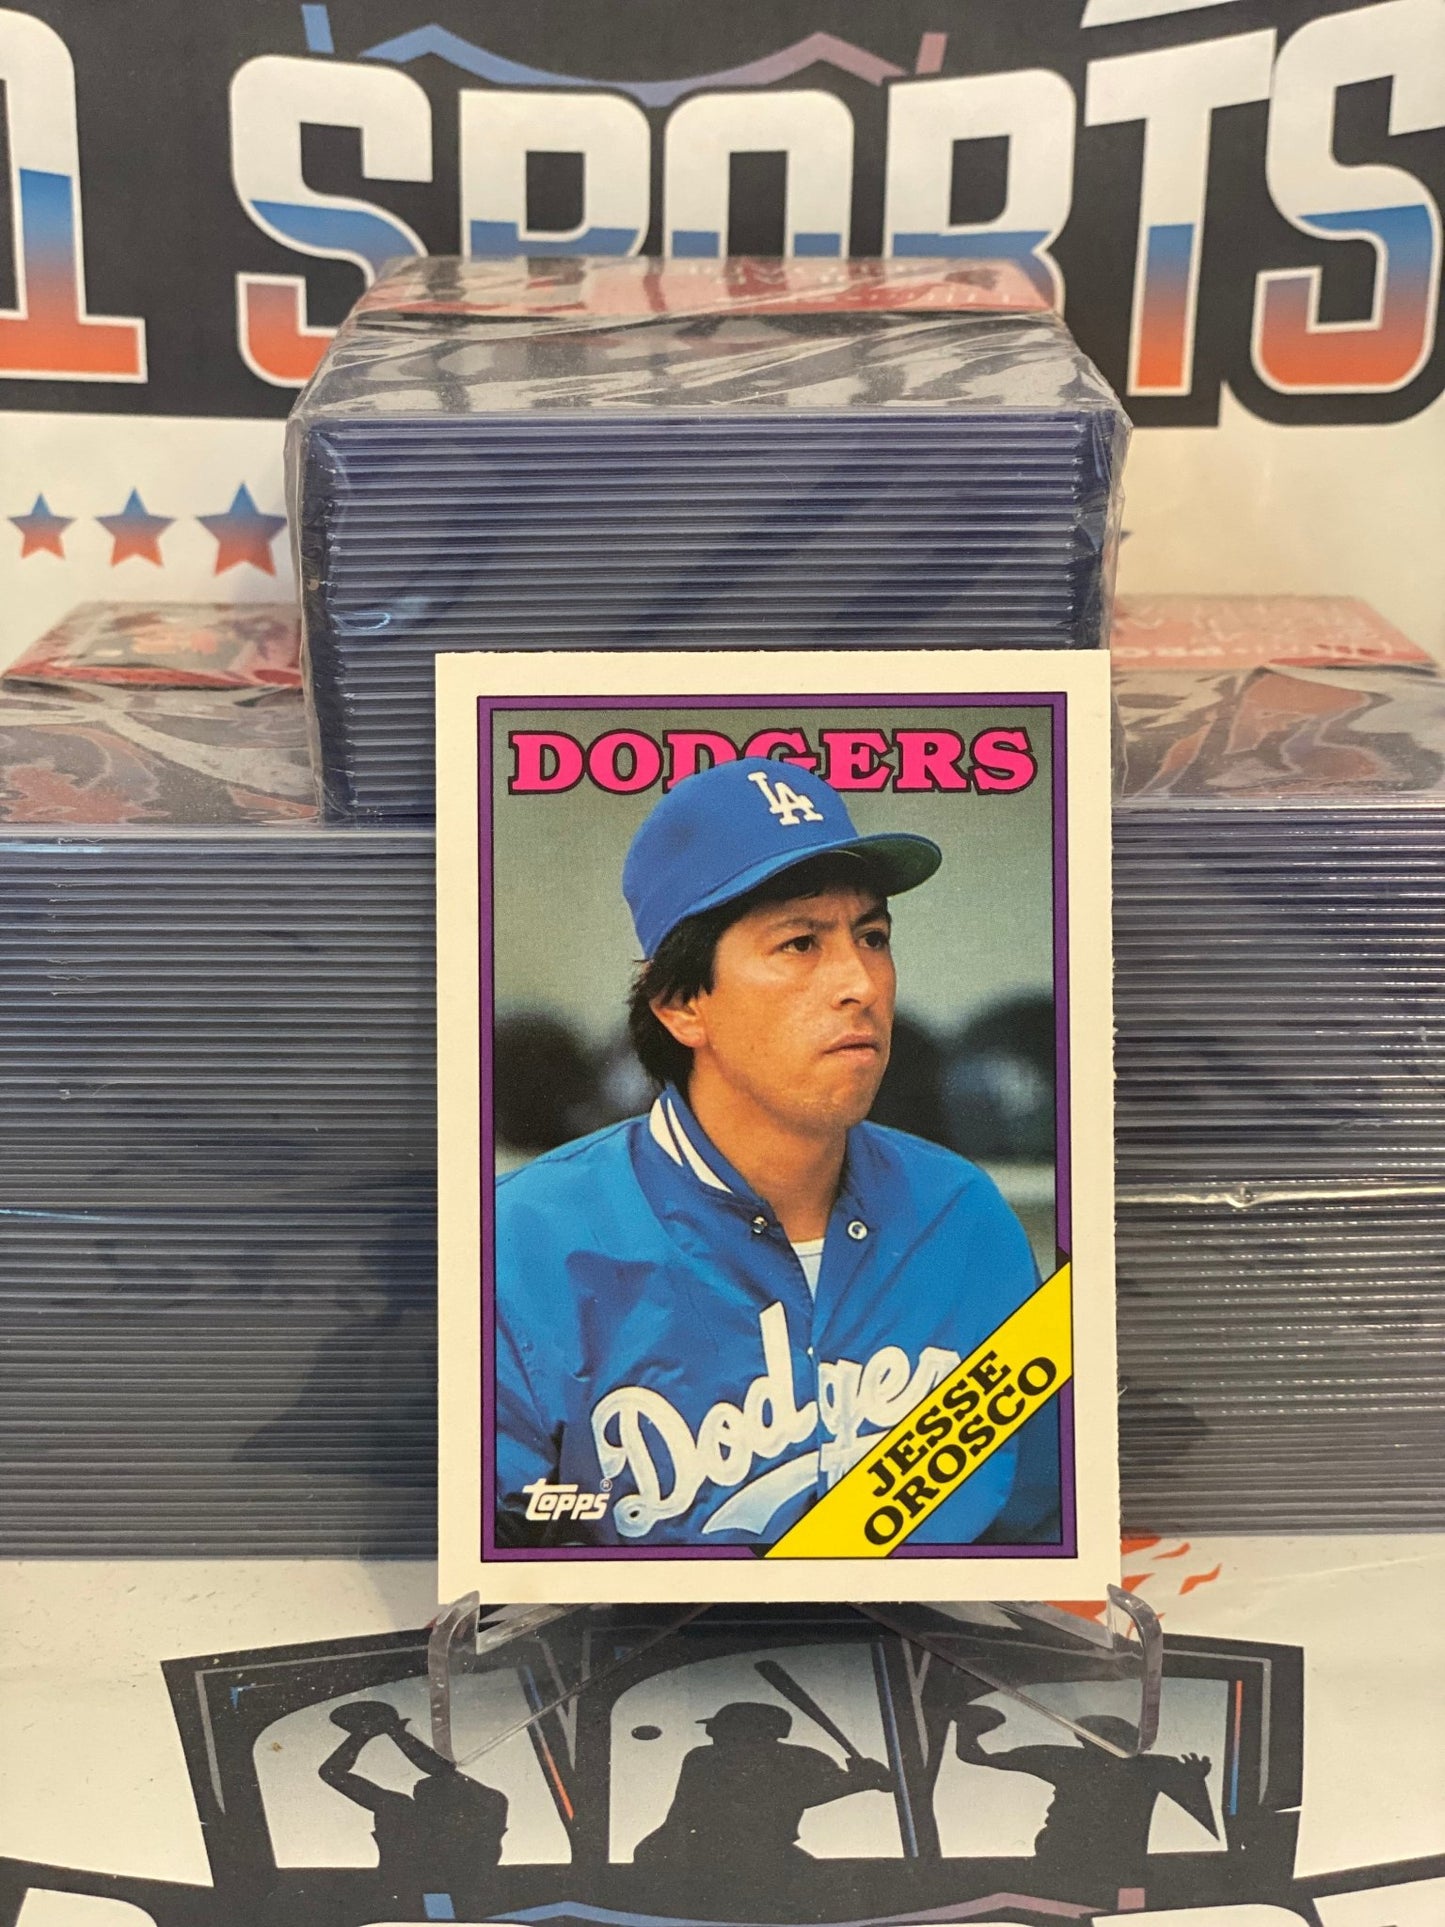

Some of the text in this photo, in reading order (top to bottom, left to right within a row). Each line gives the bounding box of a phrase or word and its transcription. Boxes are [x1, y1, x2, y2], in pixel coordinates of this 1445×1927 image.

[229, 0, 1445, 395] SPORTS
[747, 771, 824, 826] LA
[591, 1301, 963, 1538] Dodger
[864, 1356, 1057, 1545] OROSCO
[867, 1350, 1012, 1497] JESSE
